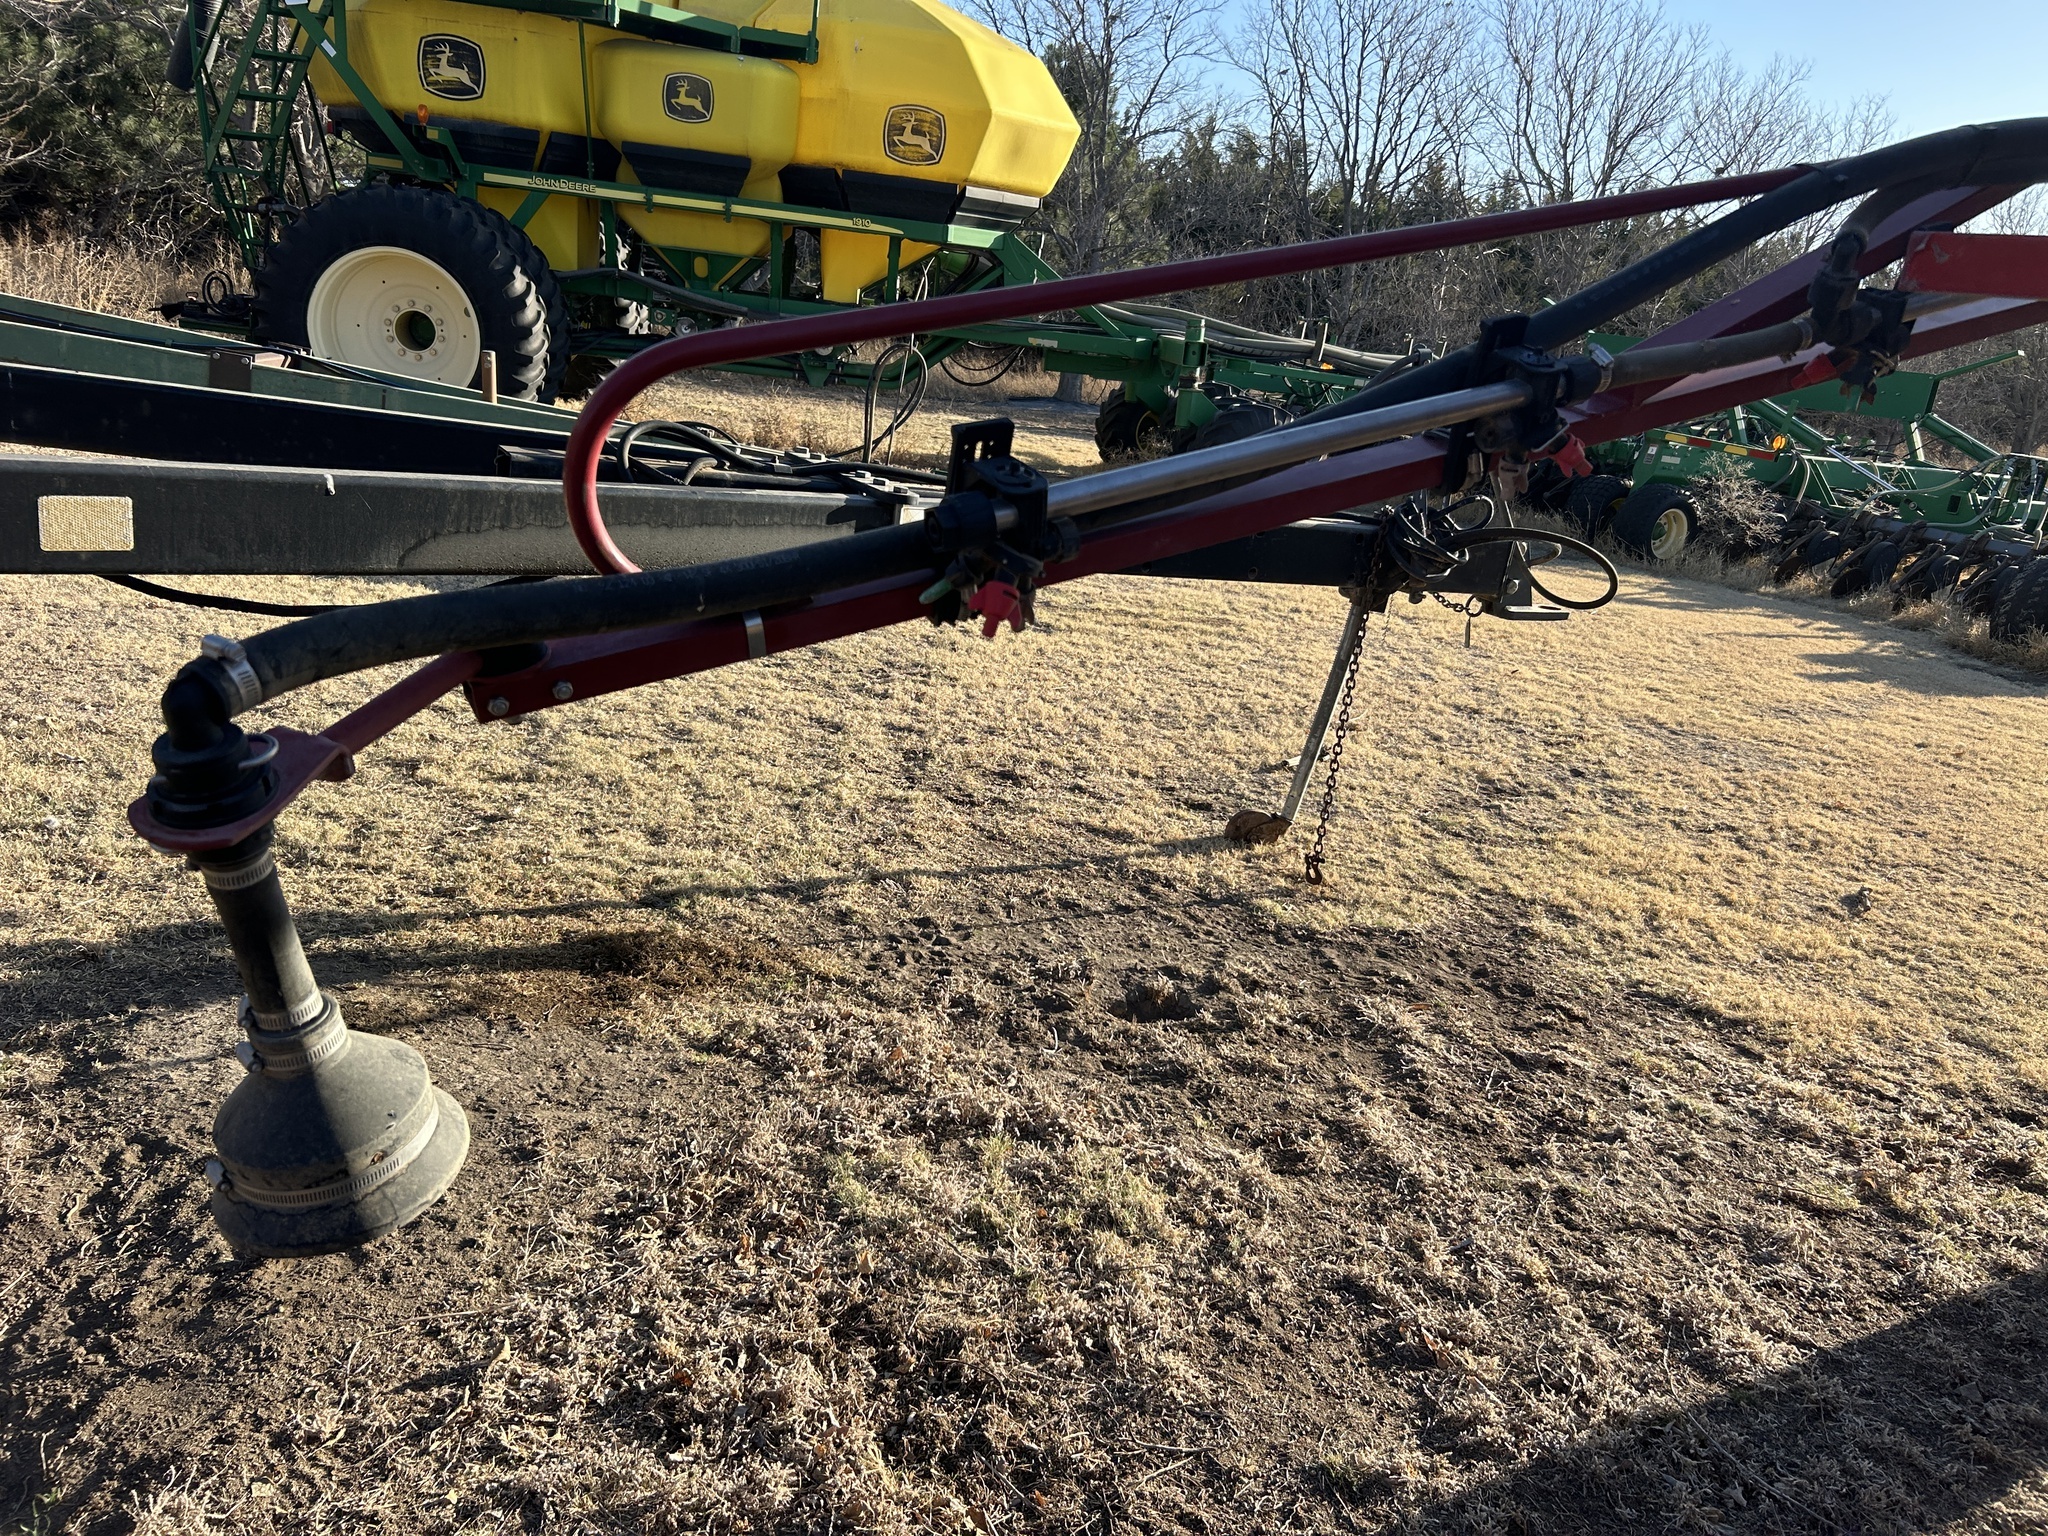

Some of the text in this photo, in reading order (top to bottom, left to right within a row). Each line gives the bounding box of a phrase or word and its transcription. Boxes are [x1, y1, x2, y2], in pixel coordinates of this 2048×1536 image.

[528, 175, 597, 193] JOHN DEERE
[852, 217, 872, 228] 1910
